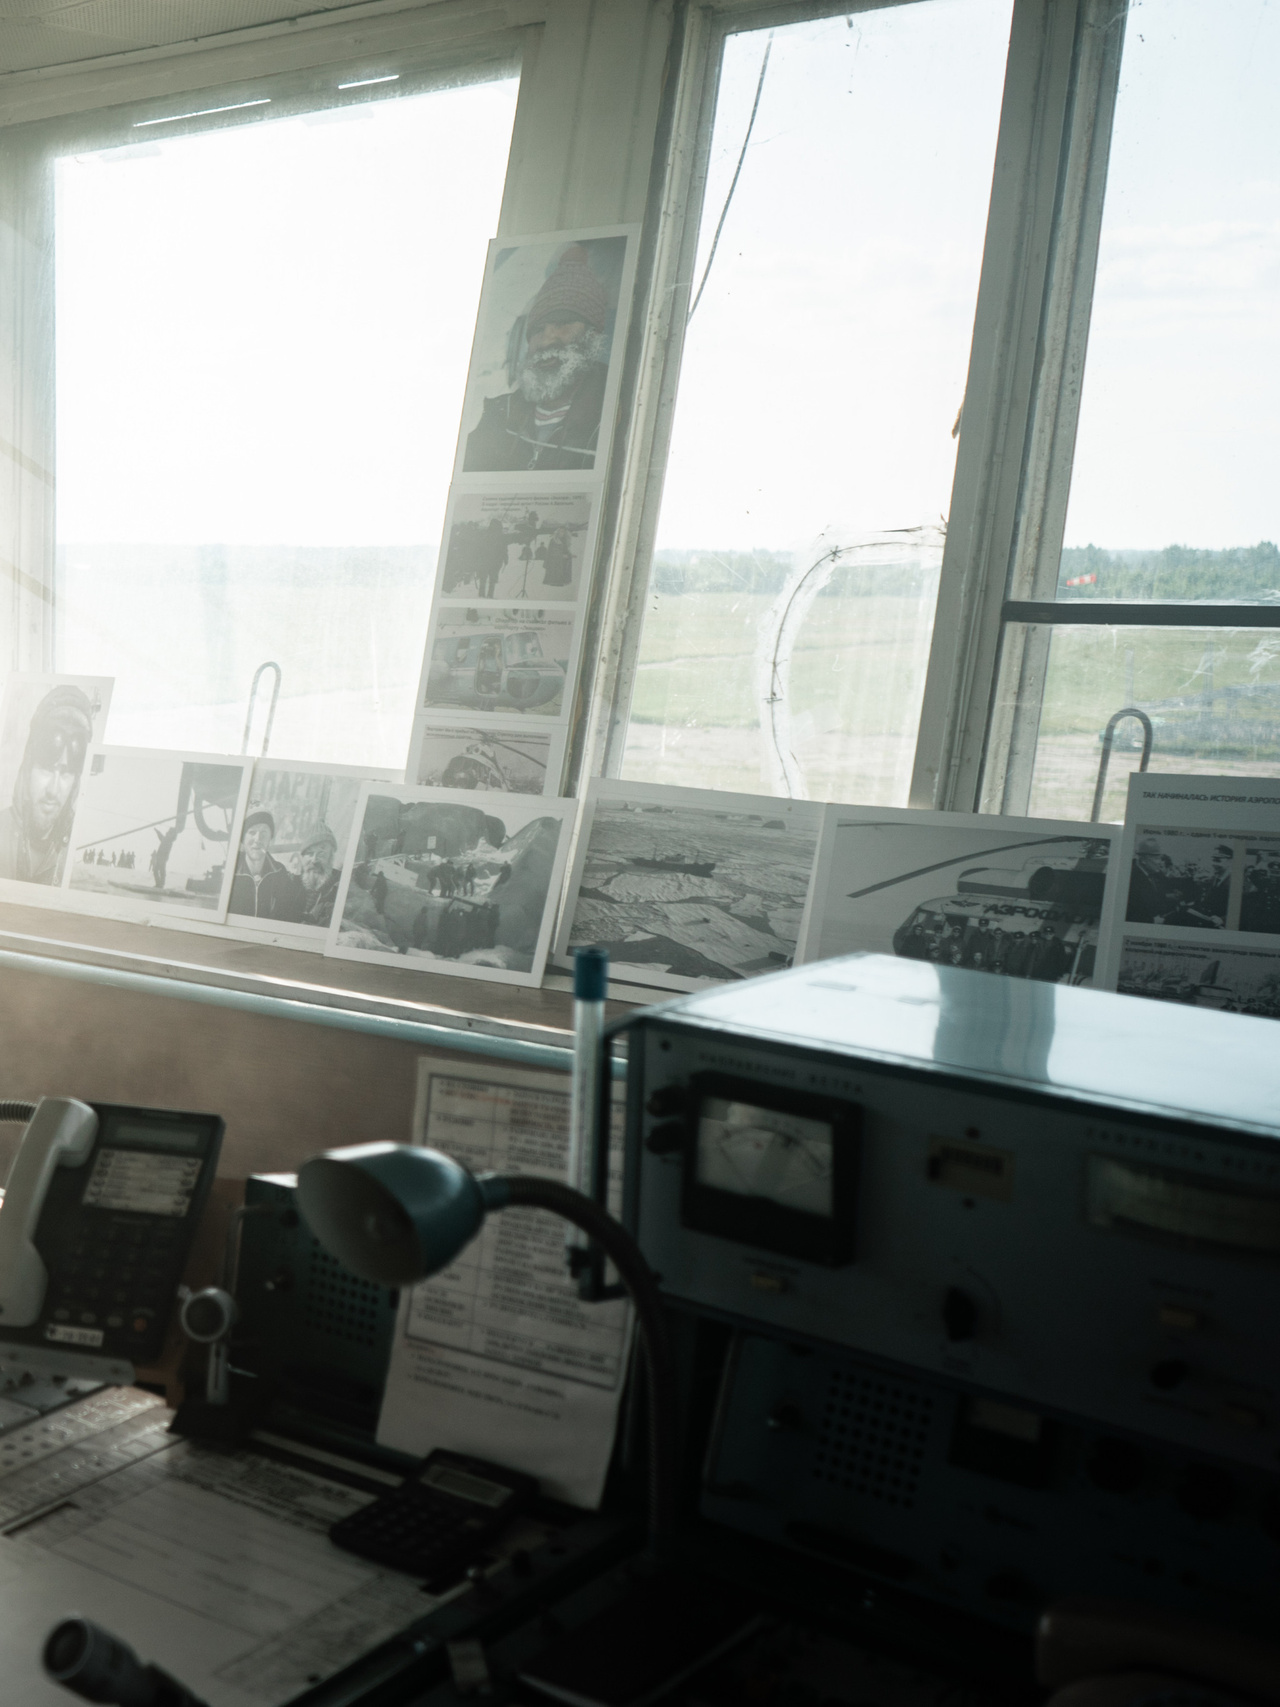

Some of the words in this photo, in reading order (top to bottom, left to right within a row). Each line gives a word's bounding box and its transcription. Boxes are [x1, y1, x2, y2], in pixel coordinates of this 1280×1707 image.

[1142, 791, 1158, 799] ТАК
[1157, 792, 1209, 802] НАЧИНАЛАСЬ
[1209, 794, 1247, 803] ИСТОРИЯ
